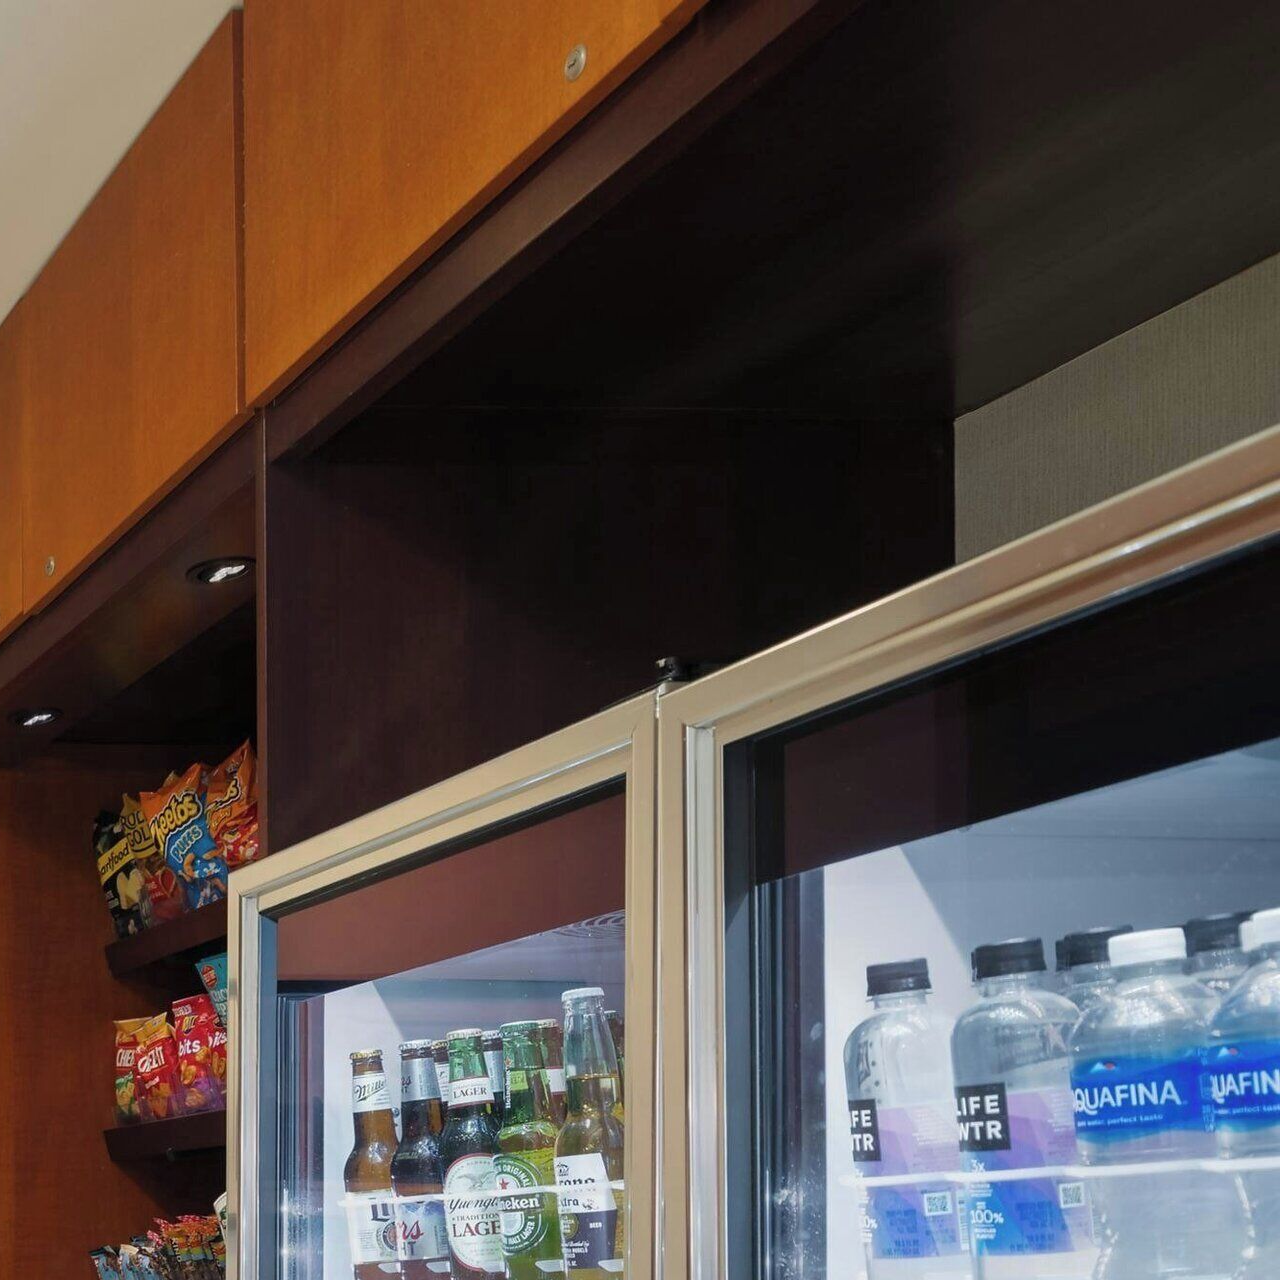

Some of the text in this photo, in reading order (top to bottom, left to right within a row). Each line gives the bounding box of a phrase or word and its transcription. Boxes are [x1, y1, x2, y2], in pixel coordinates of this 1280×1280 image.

[178, 1038, 201, 1057] bits
[453, 1086, 488, 1099] LAGER
[1107, 1115, 1137, 1126] perfect
[970, 1210, 1004, 1224] 100%
[452, 1221, 501, 1238] LAGE
